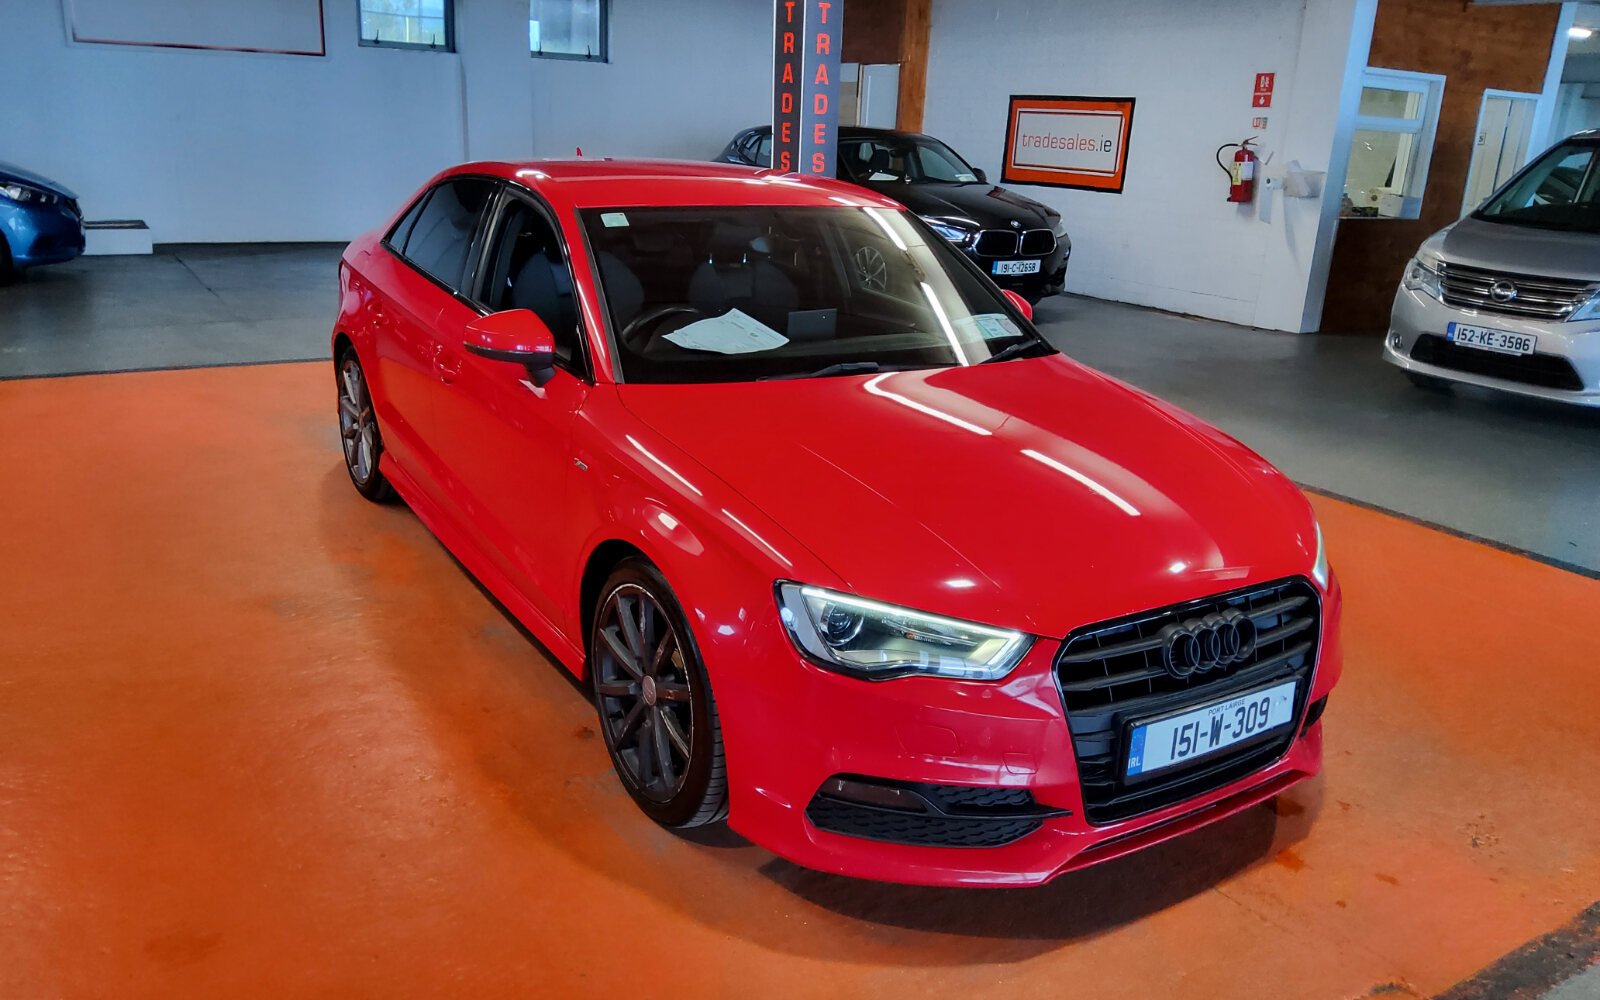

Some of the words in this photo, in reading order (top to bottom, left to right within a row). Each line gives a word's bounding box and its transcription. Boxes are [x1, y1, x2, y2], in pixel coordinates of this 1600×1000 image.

[780, 1, 796, 171] TRADES
[812, 2, 832, 173] TRADES
[1022, 131, 1112, 153] tradesales.ie
[1456, 327, 1531, 352] 152-KE-3586
[1208, 705, 1225, 716] PORT
[1170, 696, 1271, 761] 151-W-309
[1127, 756, 1141, 769] IRL
